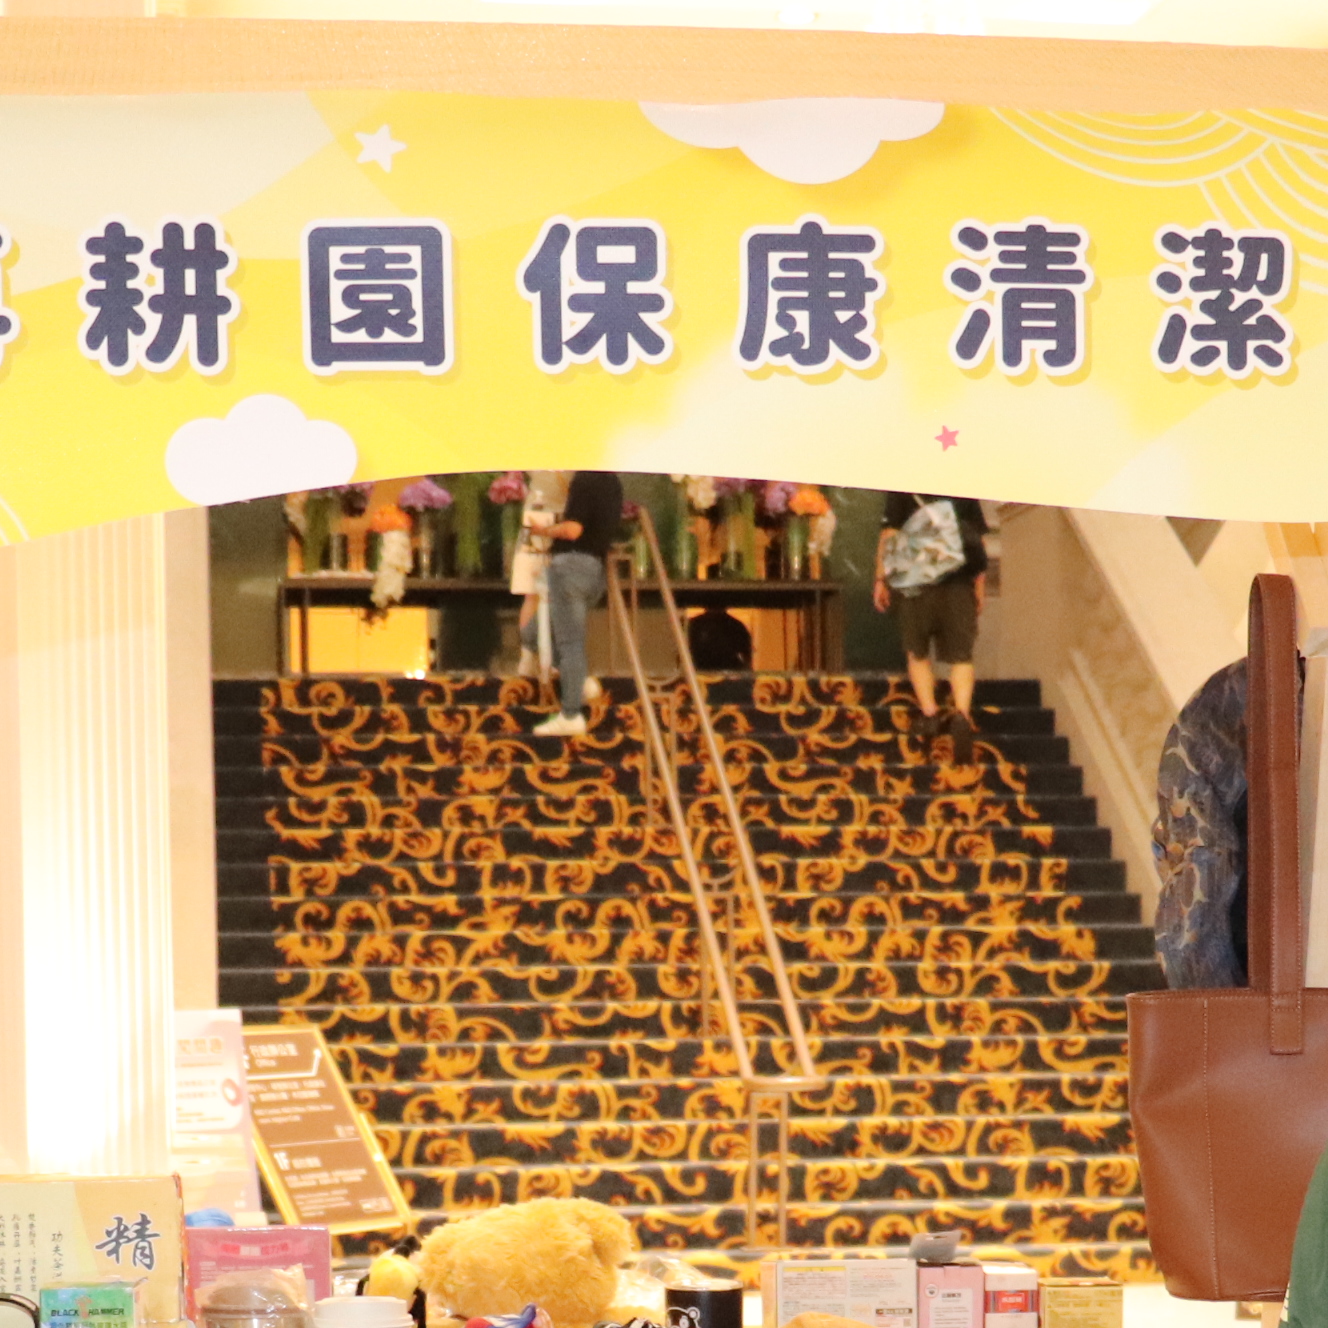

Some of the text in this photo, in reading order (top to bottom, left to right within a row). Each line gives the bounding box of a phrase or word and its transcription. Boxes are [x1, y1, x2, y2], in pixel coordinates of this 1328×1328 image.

[95, 1212, 161, 1271] 精
[51, 1307, 125, 1317] BLACK HAMMER
